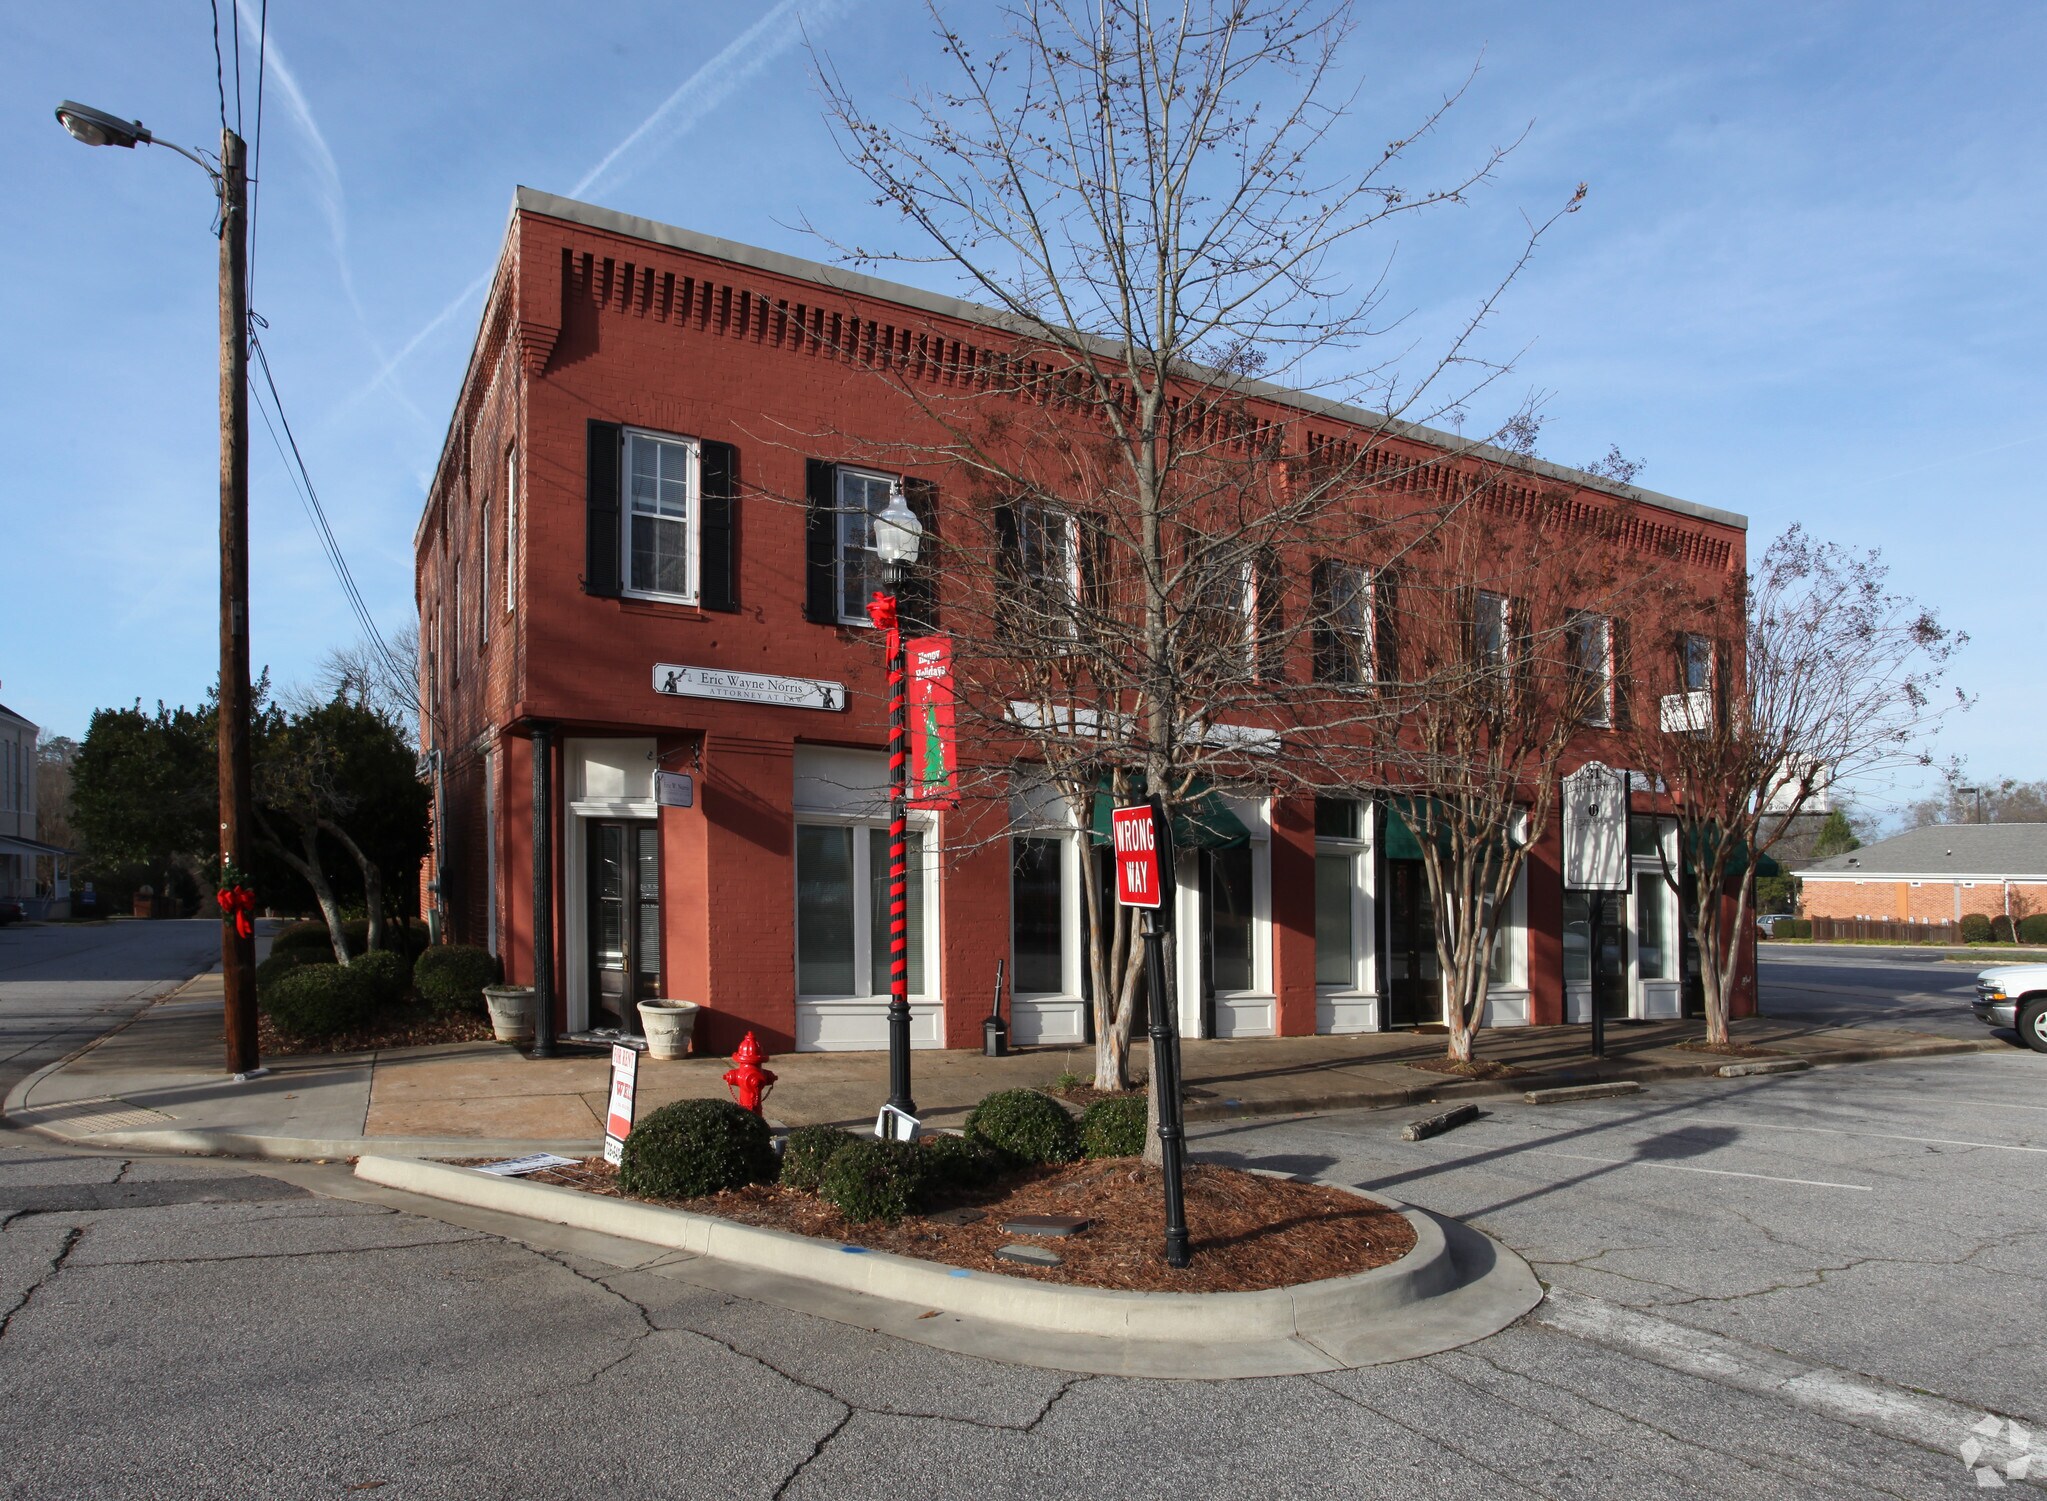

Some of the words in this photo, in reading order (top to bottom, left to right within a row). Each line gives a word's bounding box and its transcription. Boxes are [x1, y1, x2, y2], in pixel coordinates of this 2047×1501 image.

[701, 672, 723, 685] Eric
[727, 674, 764, 690] Wayne
[768, 679, 803, 693] Norris
[915, 666, 946, 681] Holidays
[710, 688, 762, 700] ATTORNEY
[1586, 769, 1600, 779] 31
[1115, 818, 1154, 851] WRONG
[1126, 861, 1147, 893] WAY
